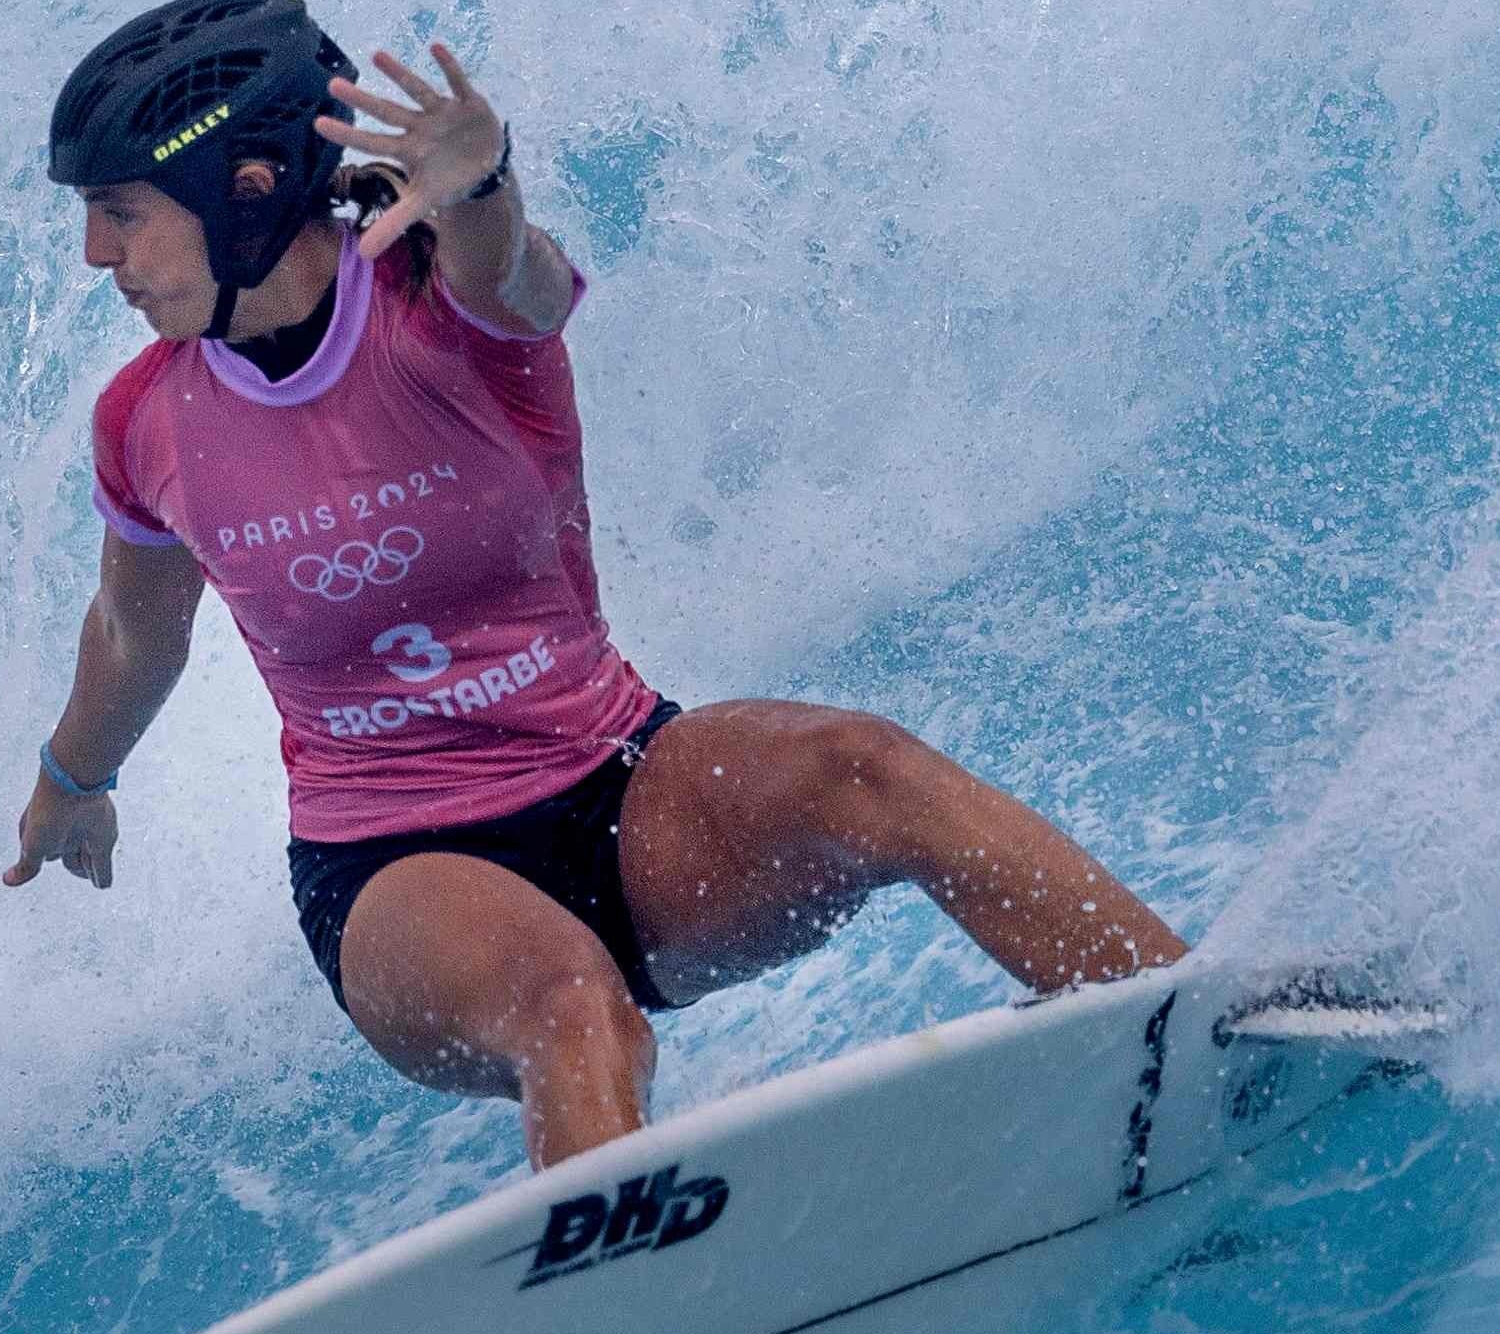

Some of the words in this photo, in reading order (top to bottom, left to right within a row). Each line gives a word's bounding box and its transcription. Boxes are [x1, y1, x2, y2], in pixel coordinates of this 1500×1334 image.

[154, 104, 229, 162] OAKLEY
[217, 505, 336, 553] PARIS
[350, 463, 458, 520] 2024
[370, 622, 452, 682] 3
[533, 1163, 730, 1270] DHD
